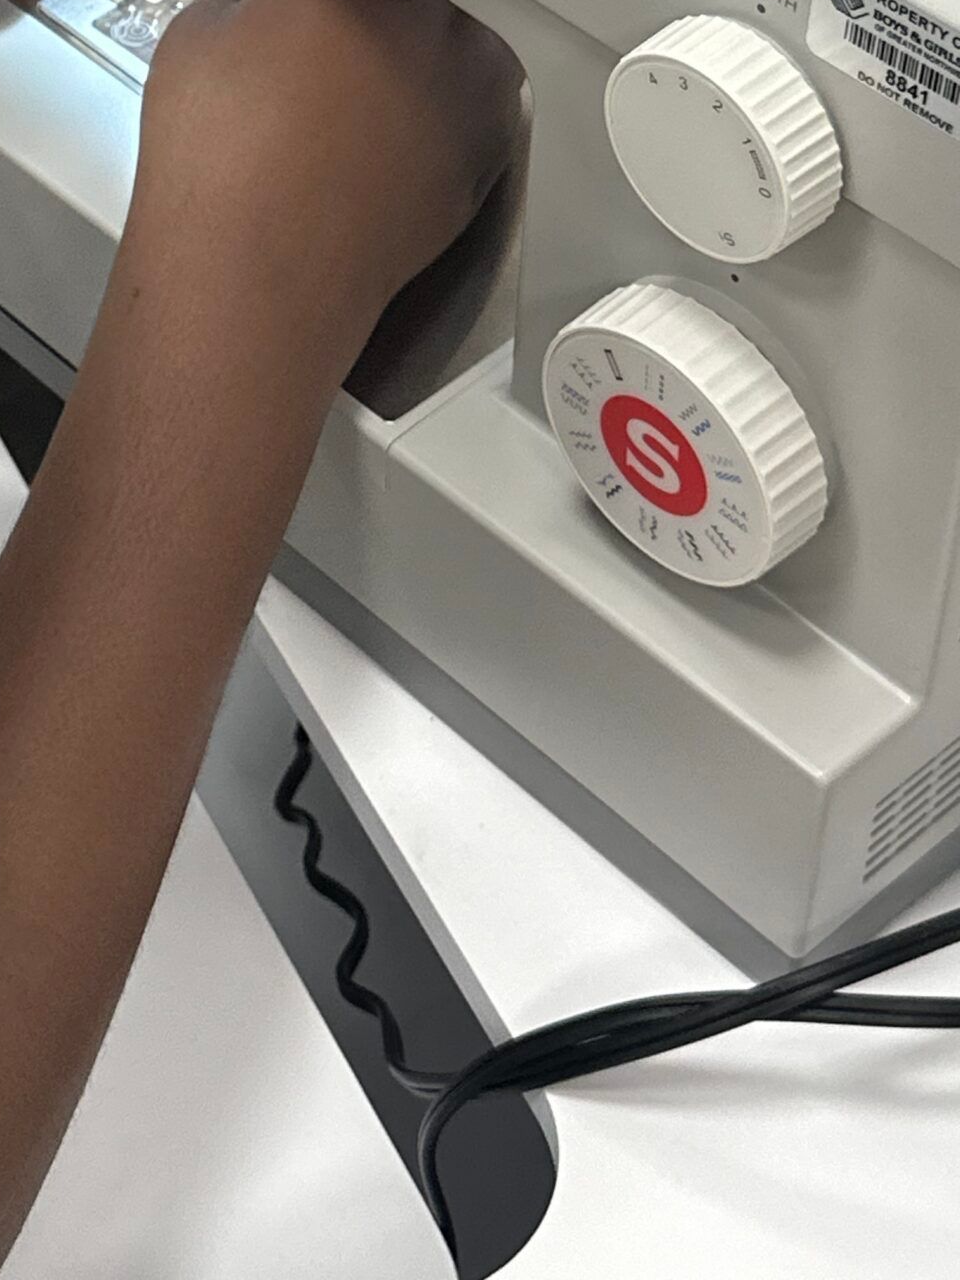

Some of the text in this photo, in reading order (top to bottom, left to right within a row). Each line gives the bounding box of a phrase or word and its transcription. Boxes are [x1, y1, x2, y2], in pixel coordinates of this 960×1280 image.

[873, 9, 908, 36] BOYS
[858, 71, 954, 135] DO NOT REMOVE
[886, 69, 929, 105] 8841
[649, 72, 658, 85] 4
[678, 76, 688, 90] 3
[712, 99, 723, 113] 2
[758, 187, 771, 198] 0
